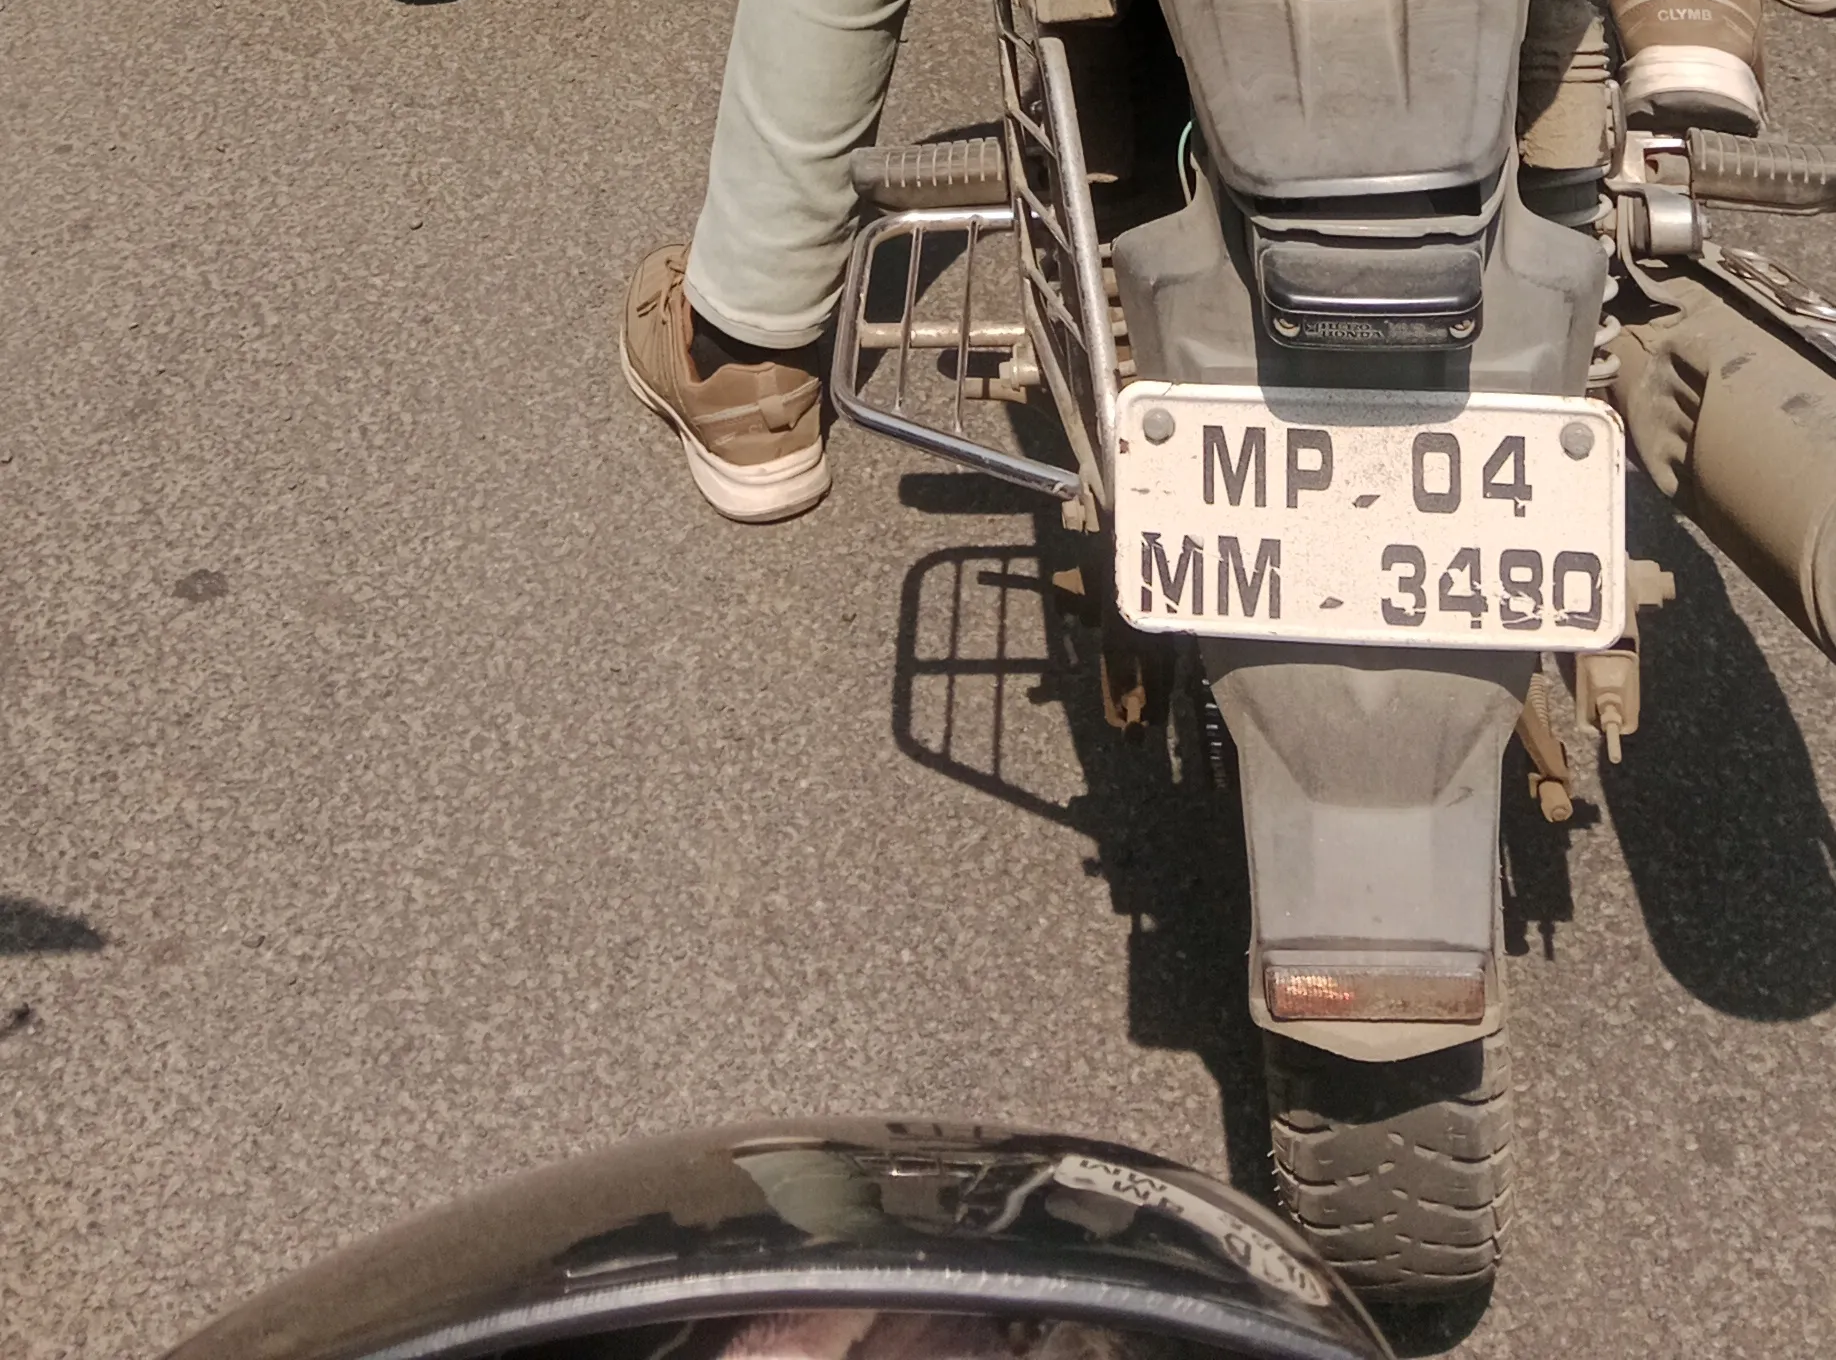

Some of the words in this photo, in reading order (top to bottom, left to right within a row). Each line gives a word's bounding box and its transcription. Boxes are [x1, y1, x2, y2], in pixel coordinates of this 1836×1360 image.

[1657, 8, 1713, 21] CLYMB
[1321, 330, 1385, 339] HONDA
[1202, 425, 1334, 509] MP
[1412, 432, 1533, 518] 04
[1140, 531, 1282, 619] MM
[1381, 544, 1602, 632] 3480
